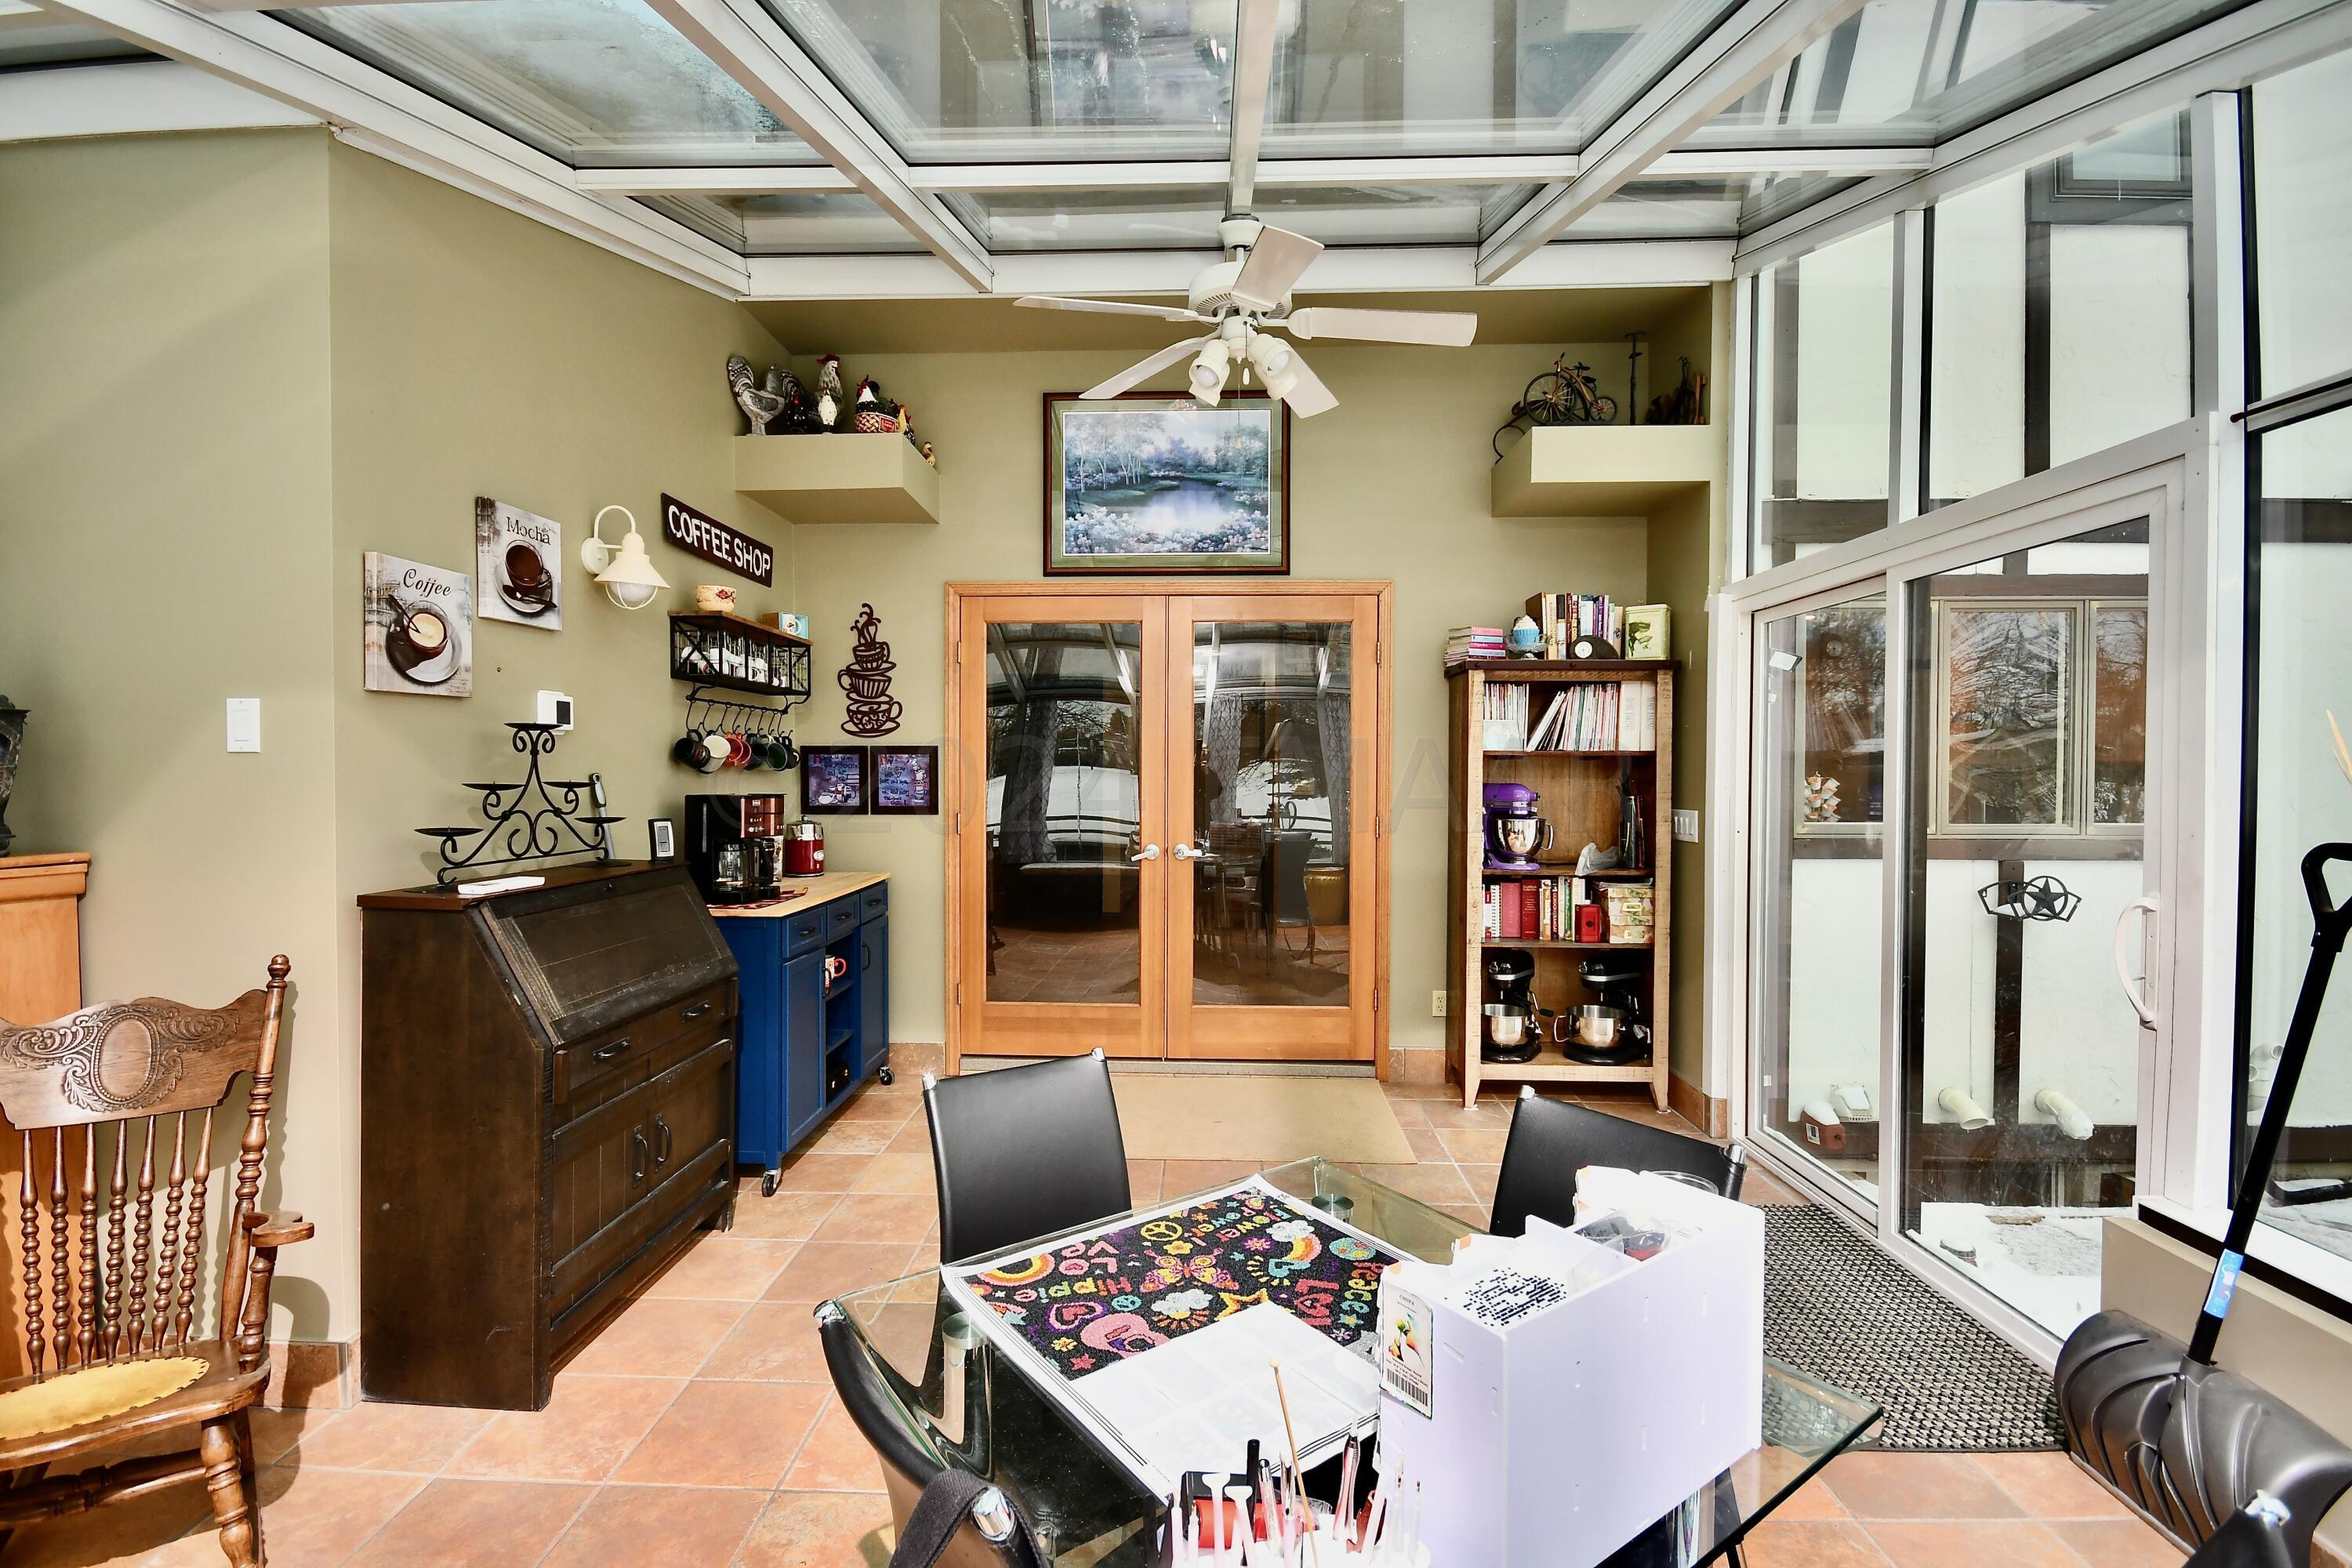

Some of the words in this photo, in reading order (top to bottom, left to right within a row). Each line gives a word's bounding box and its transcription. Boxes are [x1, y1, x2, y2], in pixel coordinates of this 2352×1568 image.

[506, 516, 551, 546] Mocha
[669, 505, 732, 564] COFFEE
[734, 538, 771, 577] SHOP
[403, 568, 452, 597] Coffee
